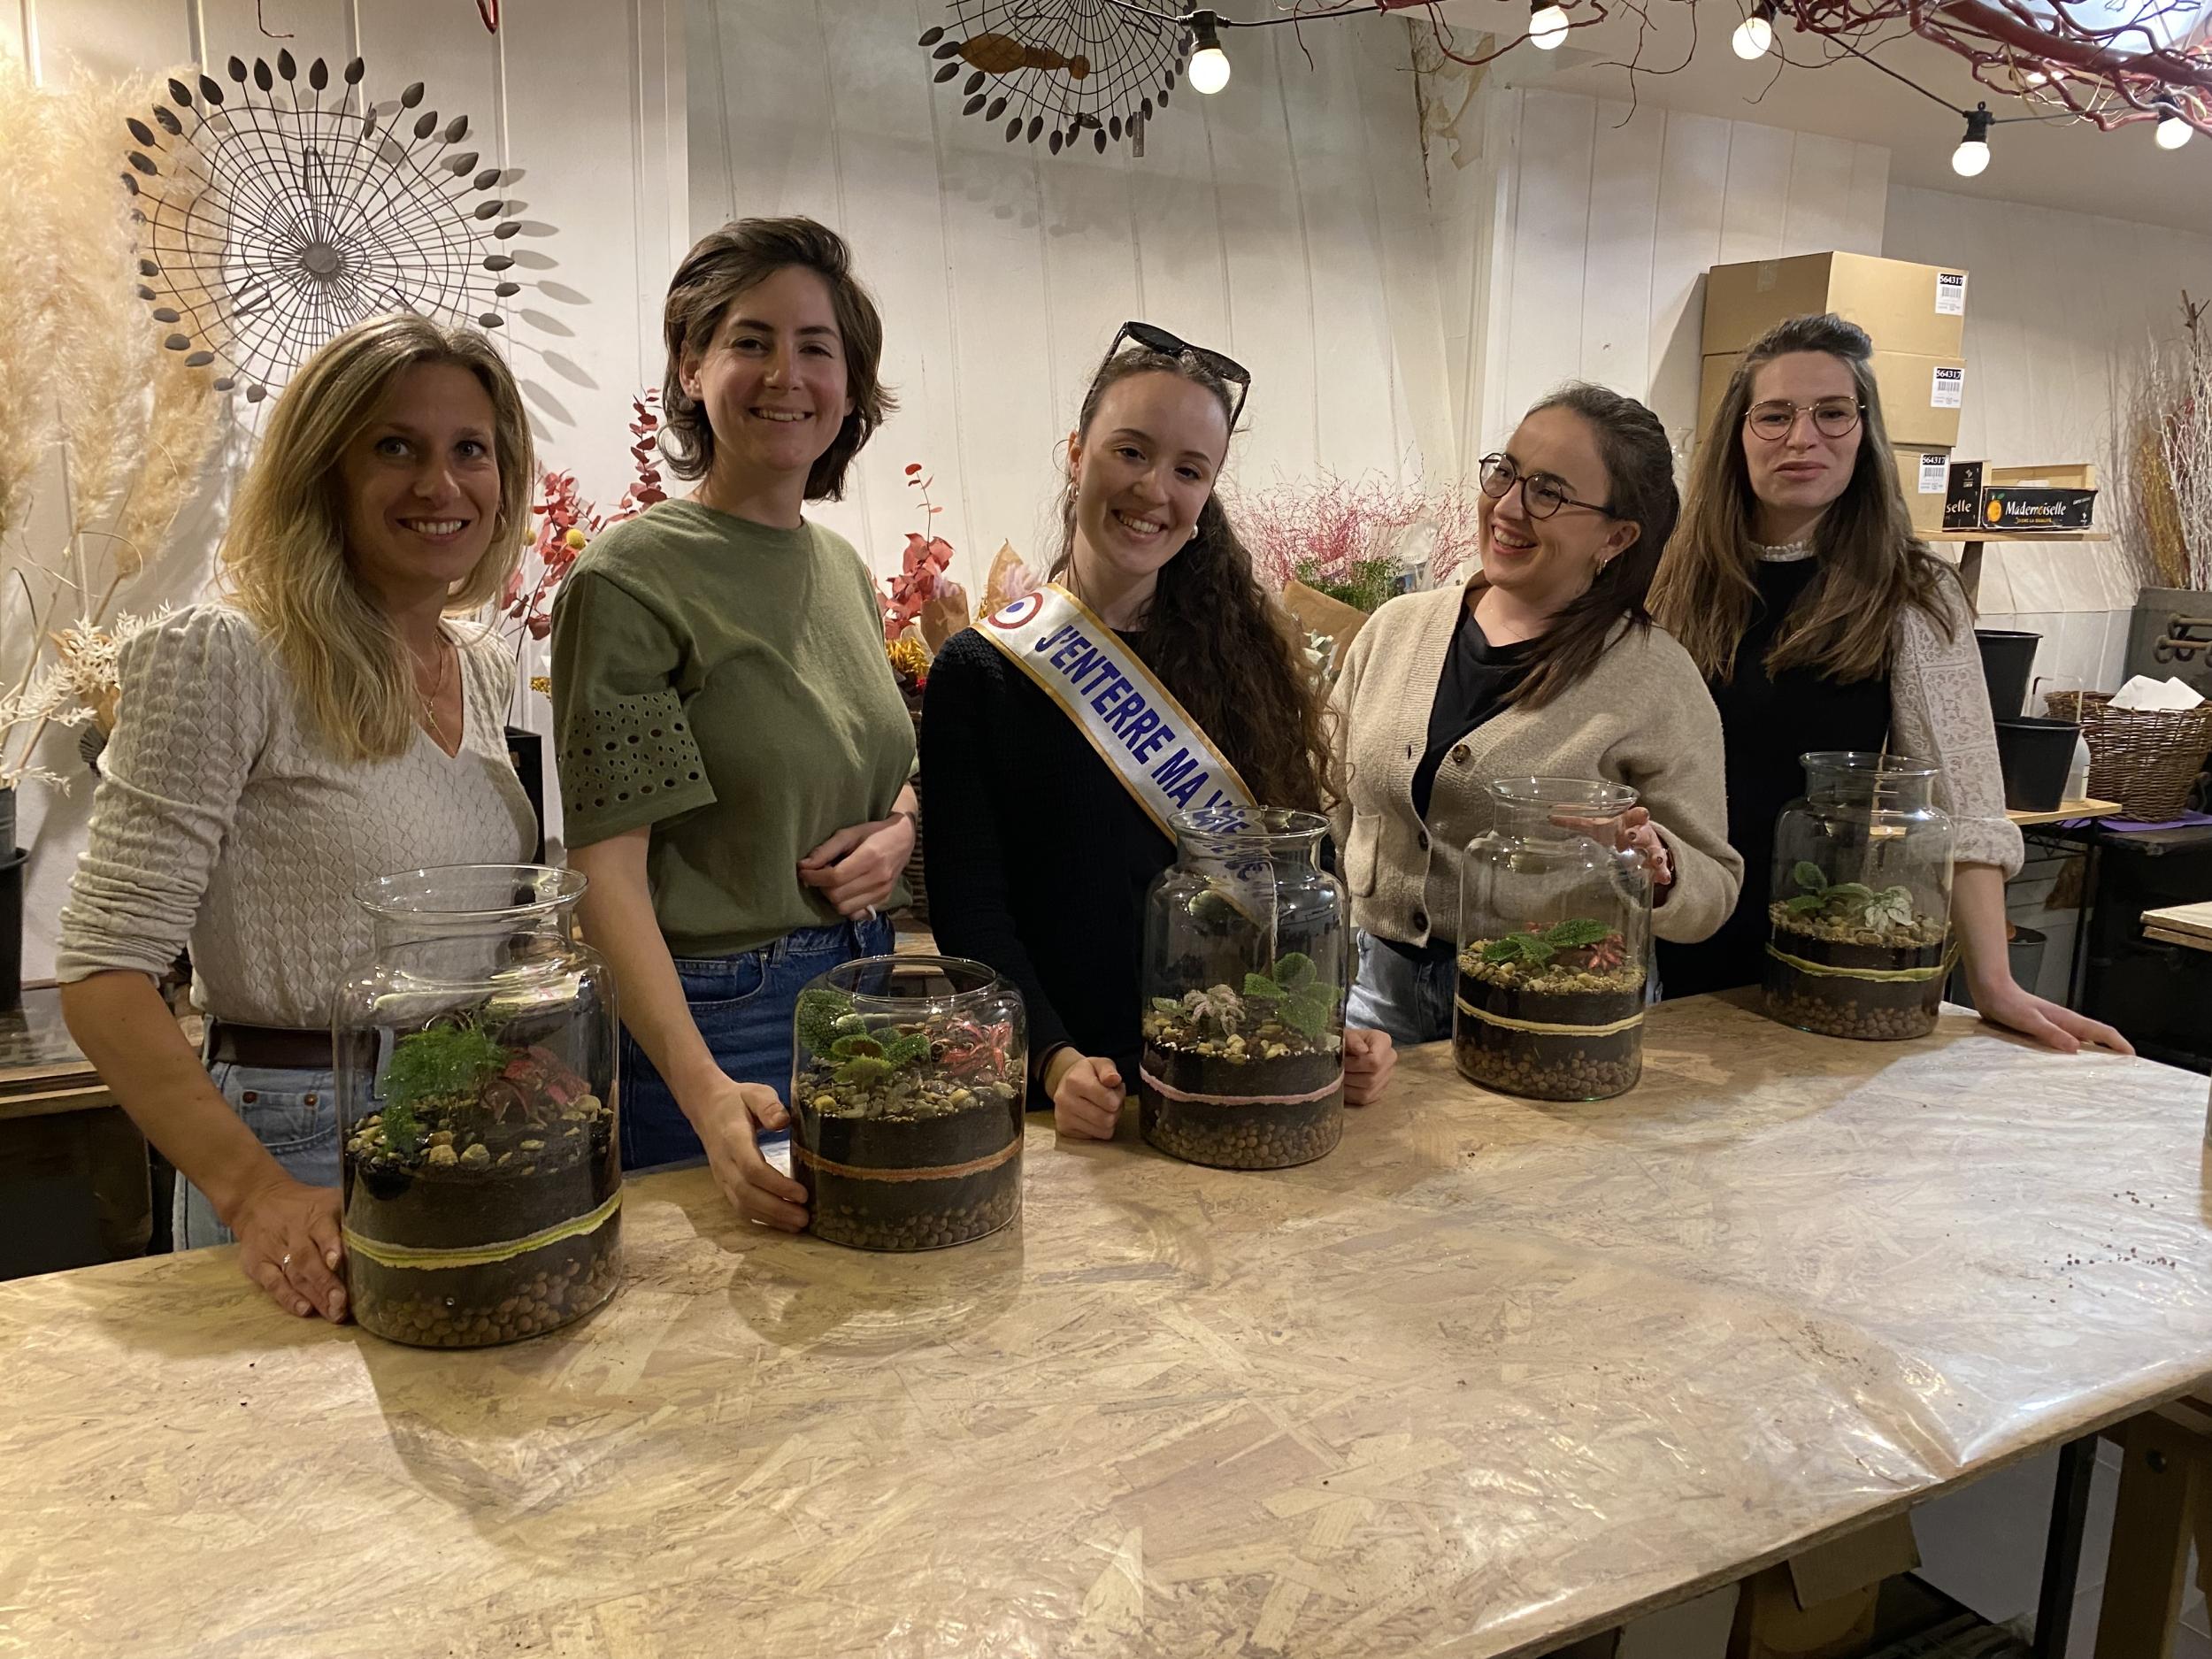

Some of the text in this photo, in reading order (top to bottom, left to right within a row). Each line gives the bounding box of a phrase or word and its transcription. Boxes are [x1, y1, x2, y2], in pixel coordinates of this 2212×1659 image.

[1939, 274, 1963, 285] 564317
[1936, 369, 1961, 379] 564317
[1923, 456, 1946, 465] 564317
[1946, 499, 1971, 513] selle
[2005, 500, 2067, 516] Mademoiselle
[1033, 625, 1175, 765] J'ENTERRE
[1150, 747, 1210, 809] MA
